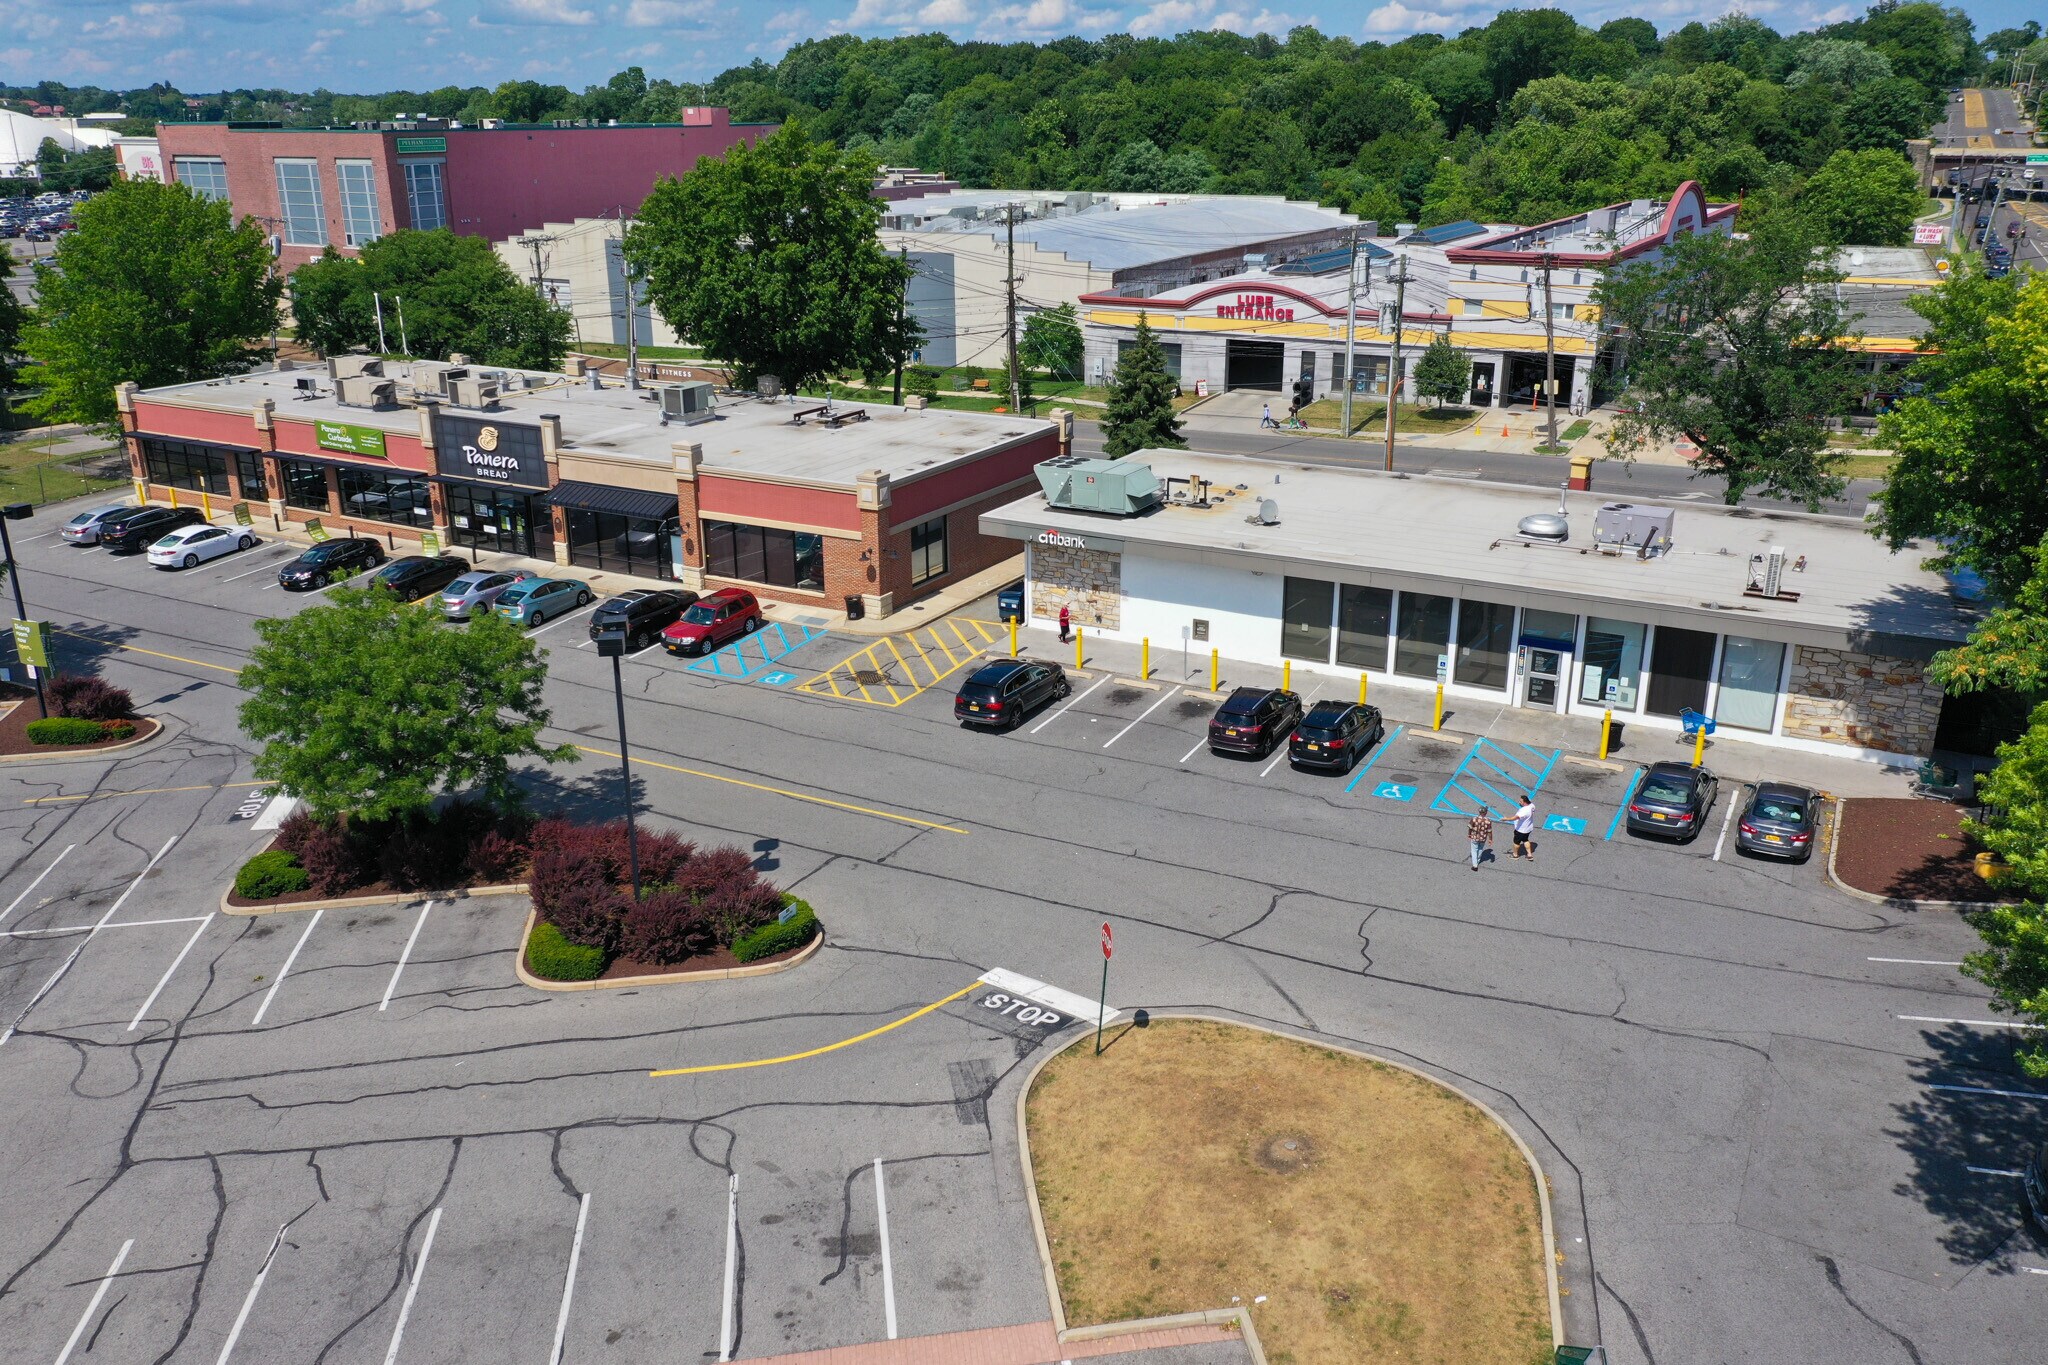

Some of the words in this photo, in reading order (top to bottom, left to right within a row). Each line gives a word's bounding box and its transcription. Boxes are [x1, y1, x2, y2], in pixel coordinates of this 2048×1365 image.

[1237, 295, 1273, 307] LUBE
[1217, 305, 1294, 322] ENTRANCE
[639, 367, 660, 375] LEVL
[661, 368, 692, 378] FITNESS
[321, 424, 341, 434] Panera
[328, 433, 352, 444] Curbside
[462, 445, 519, 470] Panera
[476, 468, 508, 479] BREAD
[1038, 530, 1085, 549] citibank
[984, 993, 1061, 1026] STOP
